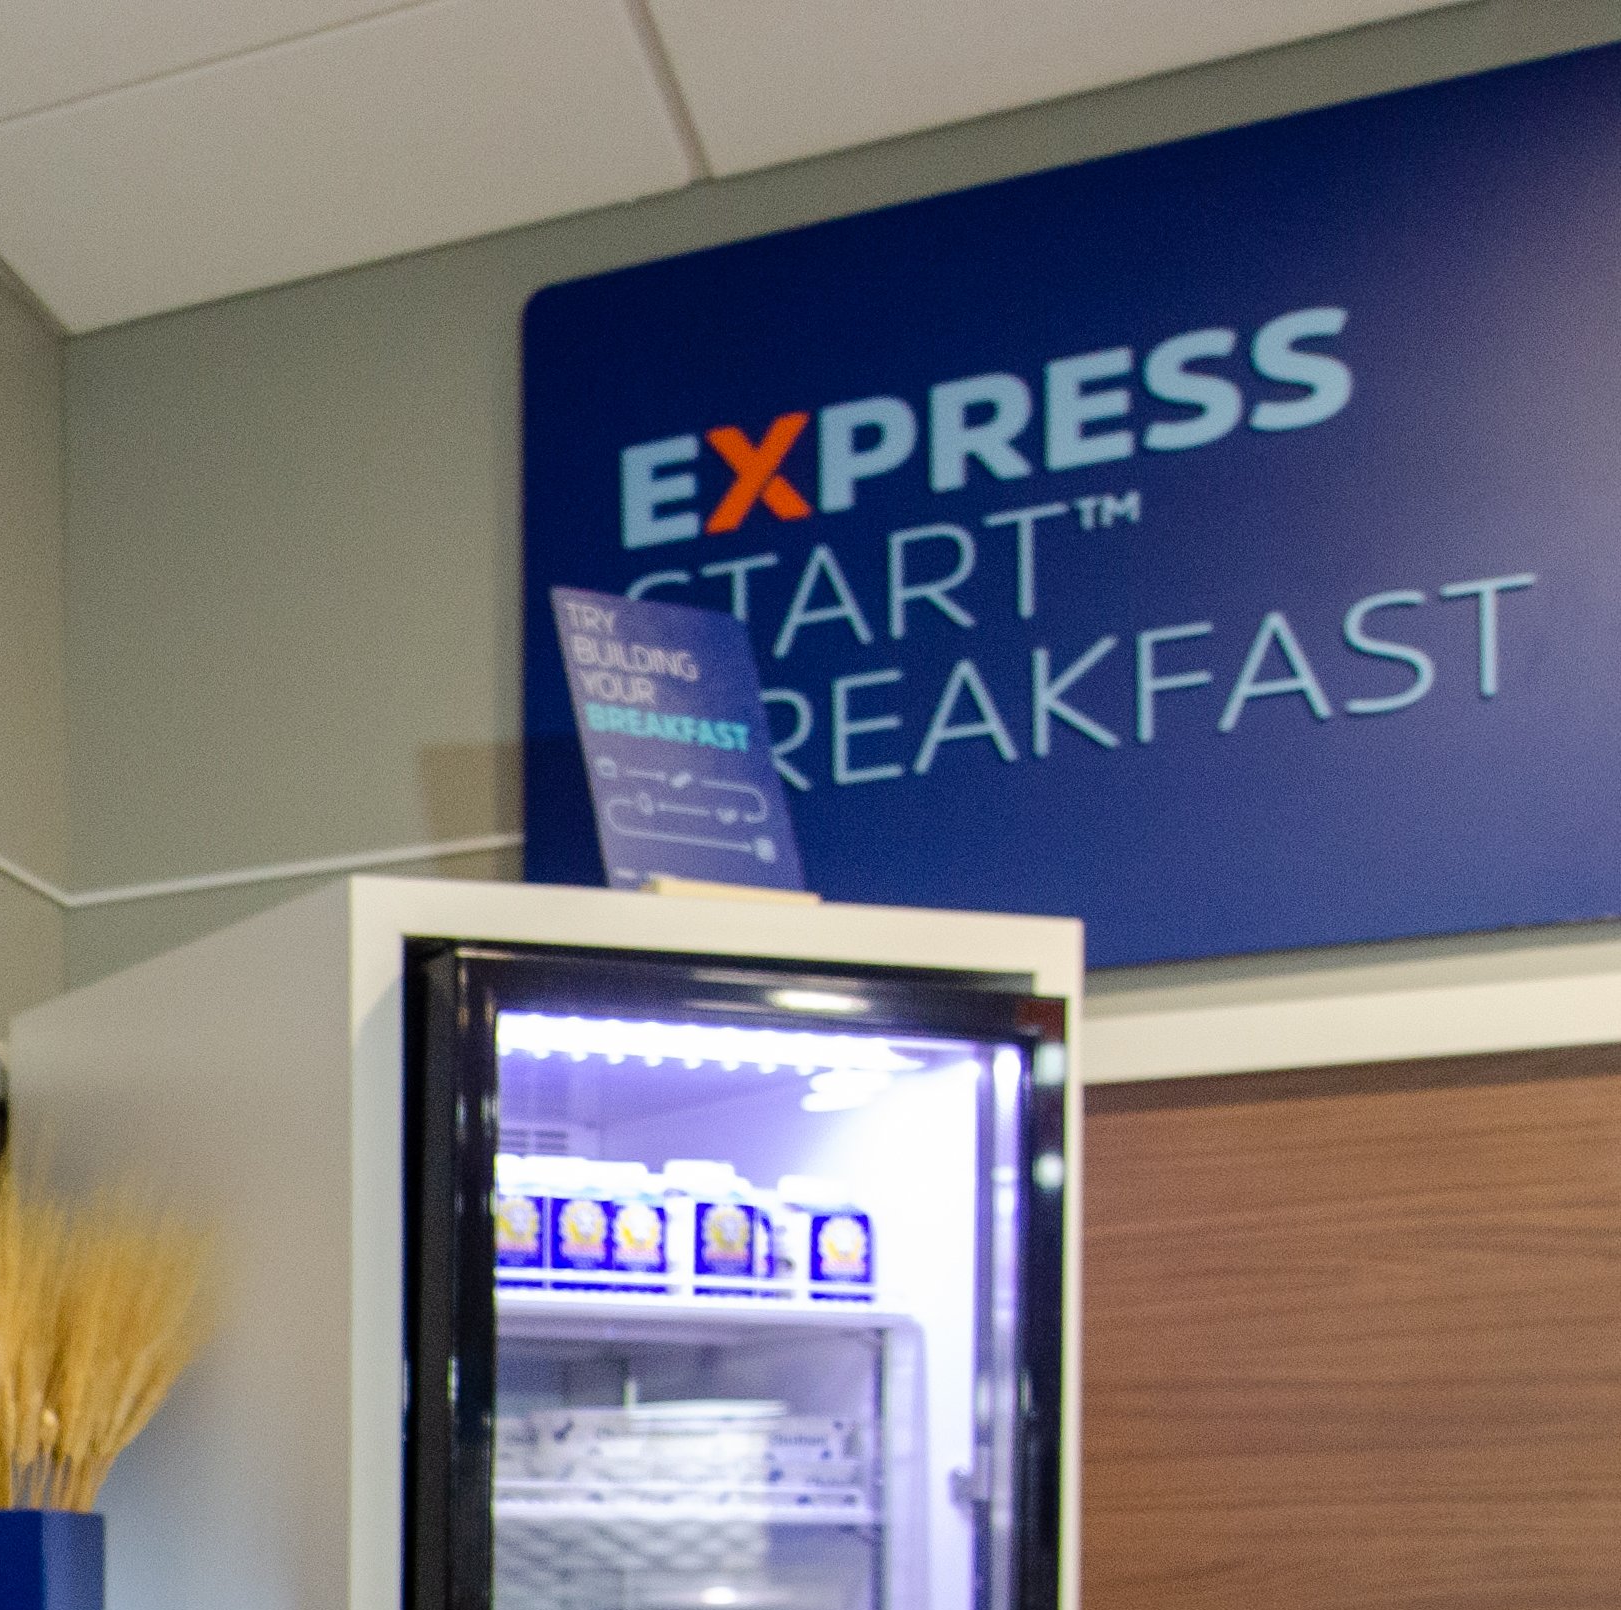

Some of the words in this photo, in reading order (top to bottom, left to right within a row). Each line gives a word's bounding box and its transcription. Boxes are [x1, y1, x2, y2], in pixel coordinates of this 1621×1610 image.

[619, 306, 1354, 549] EXPRESS
[566, 601, 617, 634] TRY
[571, 635, 700, 683] BUILDING
[759, 571, 1538, 791] REAKFAST
[579, 670, 656, 705] YOUR
[584, 701, 750, 752] BREAKFAST
